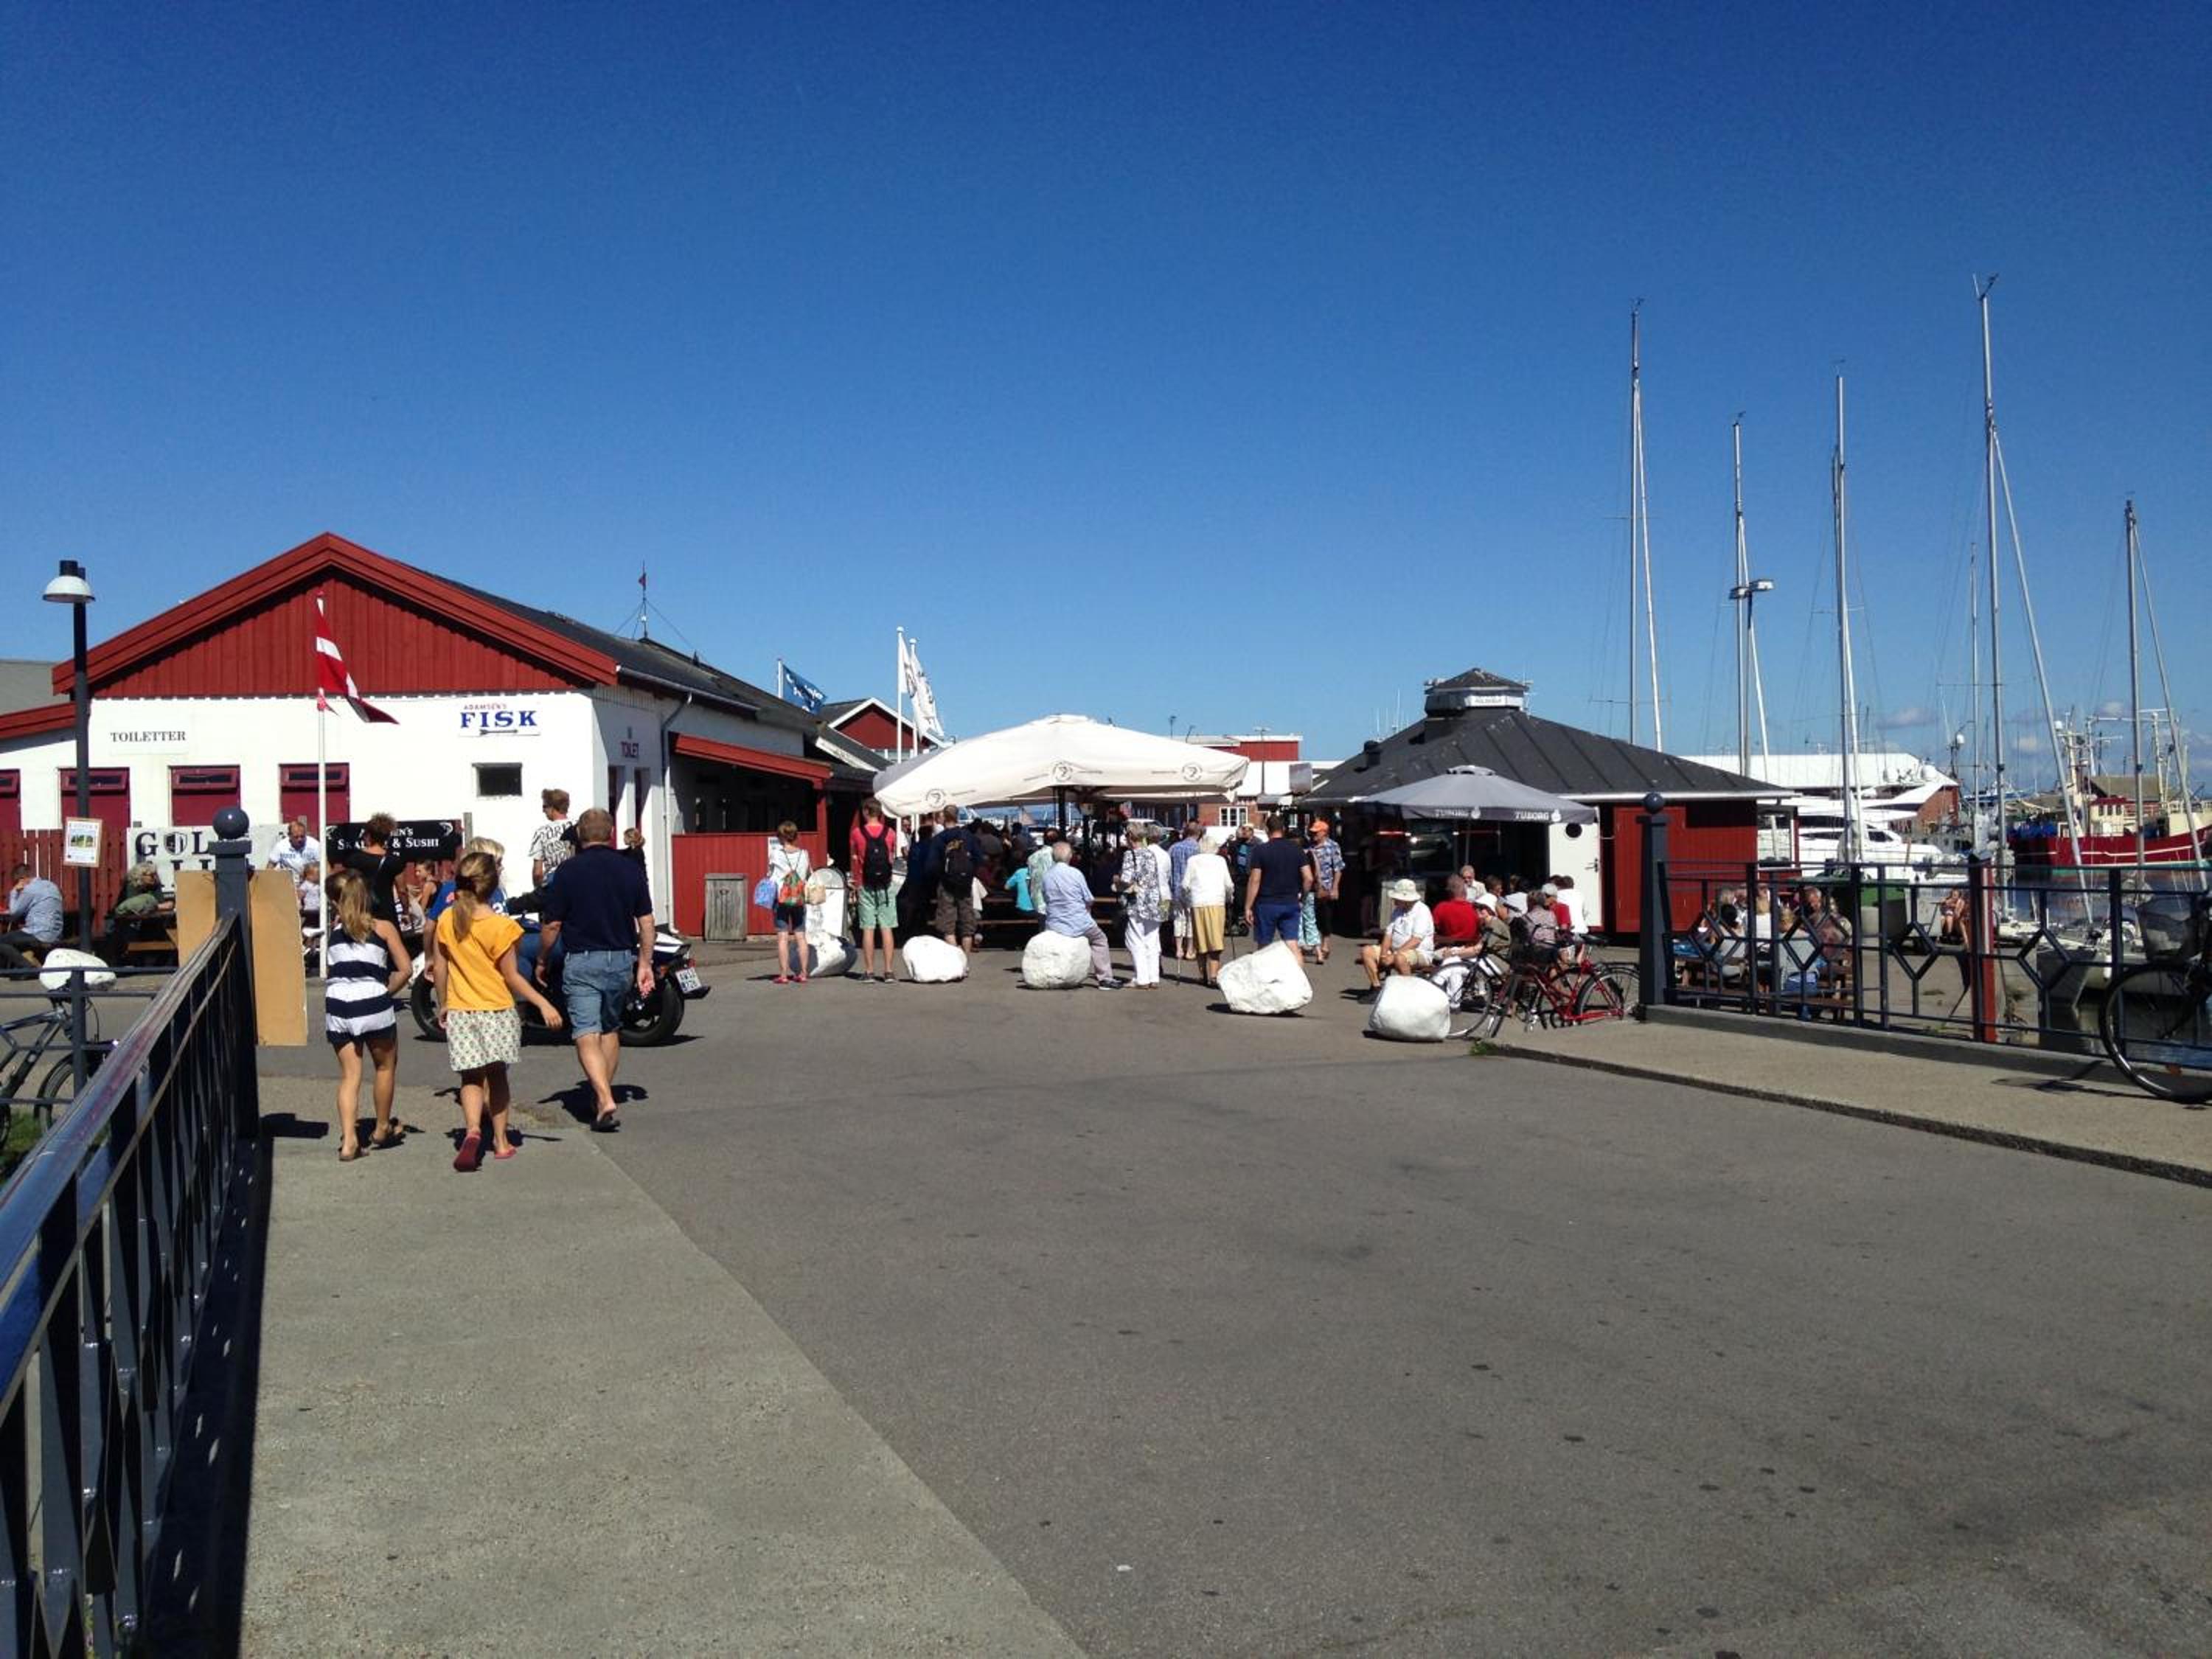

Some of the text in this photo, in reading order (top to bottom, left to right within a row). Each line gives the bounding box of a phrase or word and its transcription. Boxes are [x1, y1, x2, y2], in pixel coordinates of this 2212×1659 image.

[459, 710, 538, 728] FISK
[110, 731, 186, 742] TOILETTER
[1514, 811, 1549, 821] TUBORG
[392, 838, 400, 849] &
